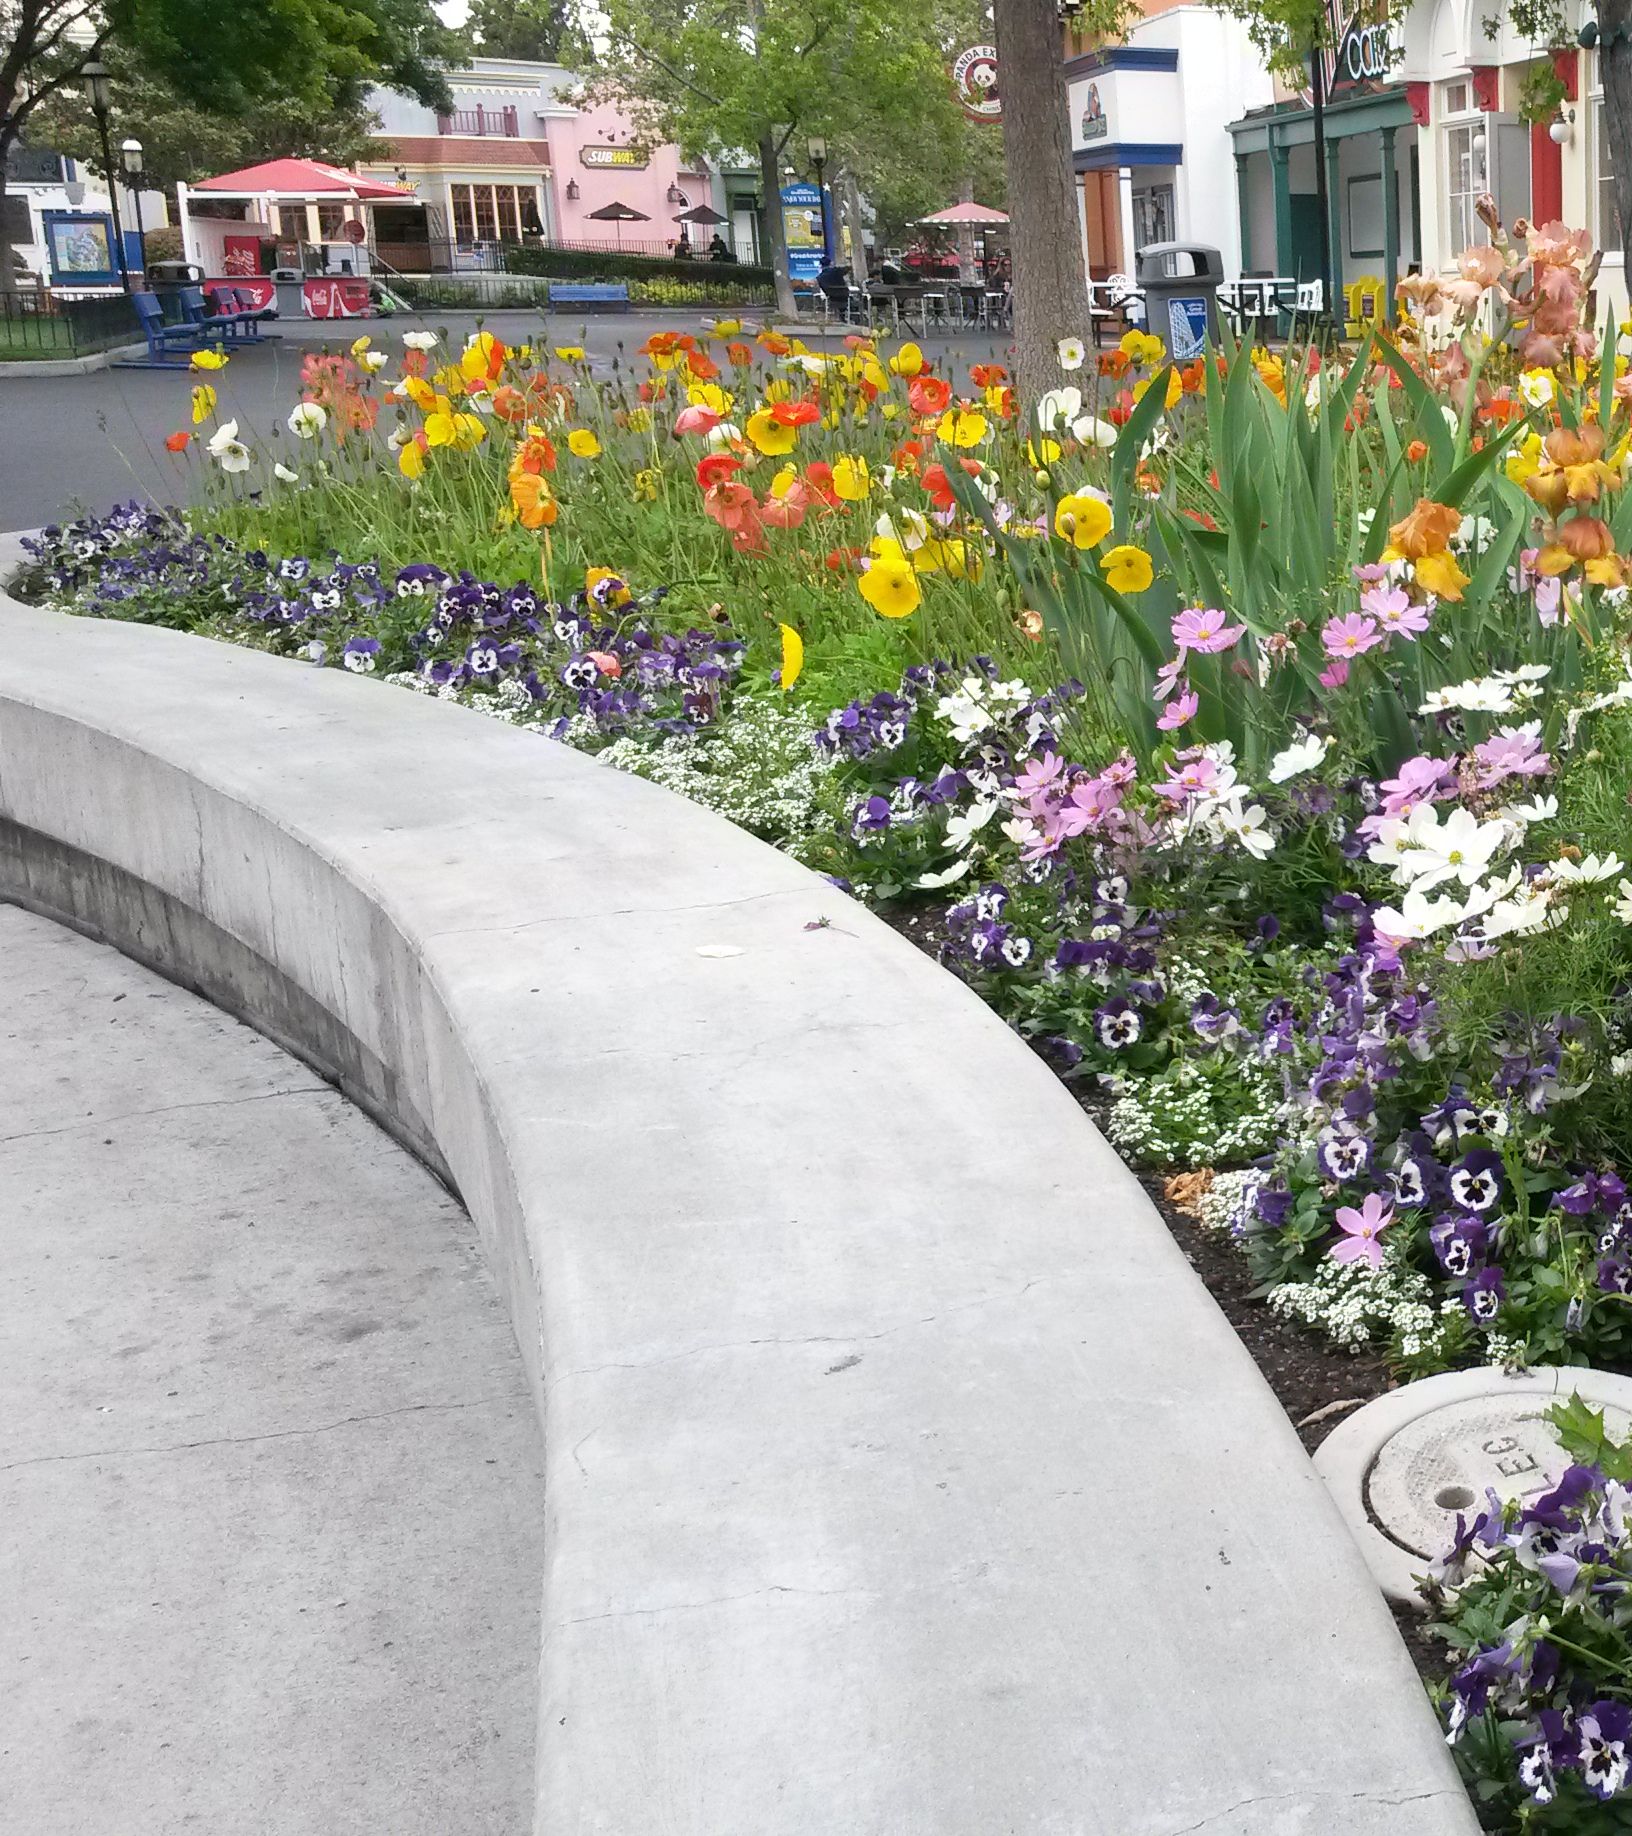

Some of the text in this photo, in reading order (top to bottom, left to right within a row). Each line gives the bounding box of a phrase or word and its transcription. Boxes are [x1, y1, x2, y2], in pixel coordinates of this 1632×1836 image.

[956, 47, 996, 79] PANDA EX
[380, 180, 420, 191] BWAY
[1481, 1436, 1558, 1500] LEC
